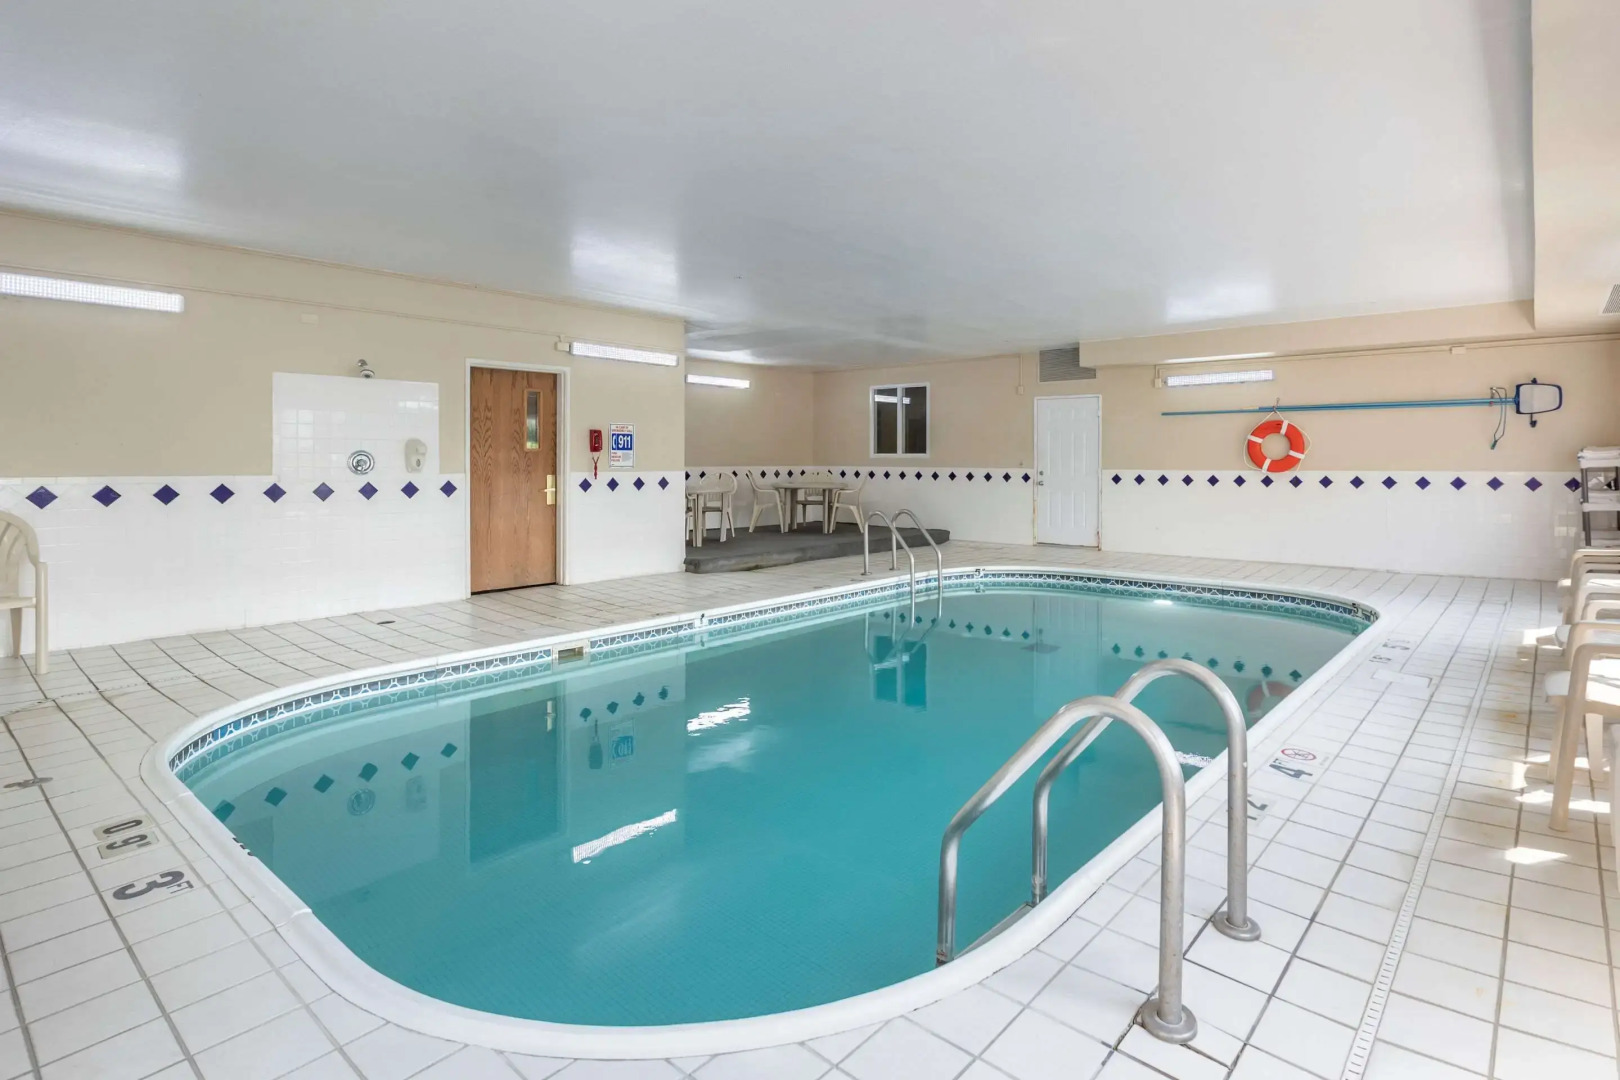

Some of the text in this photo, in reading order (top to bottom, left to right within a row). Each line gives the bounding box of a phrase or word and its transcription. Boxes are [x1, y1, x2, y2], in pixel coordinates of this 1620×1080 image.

[618, 435, 631, 448] 911
[1269, 764, 1314, 779] 4
[112, 870, 185, 901] 3
